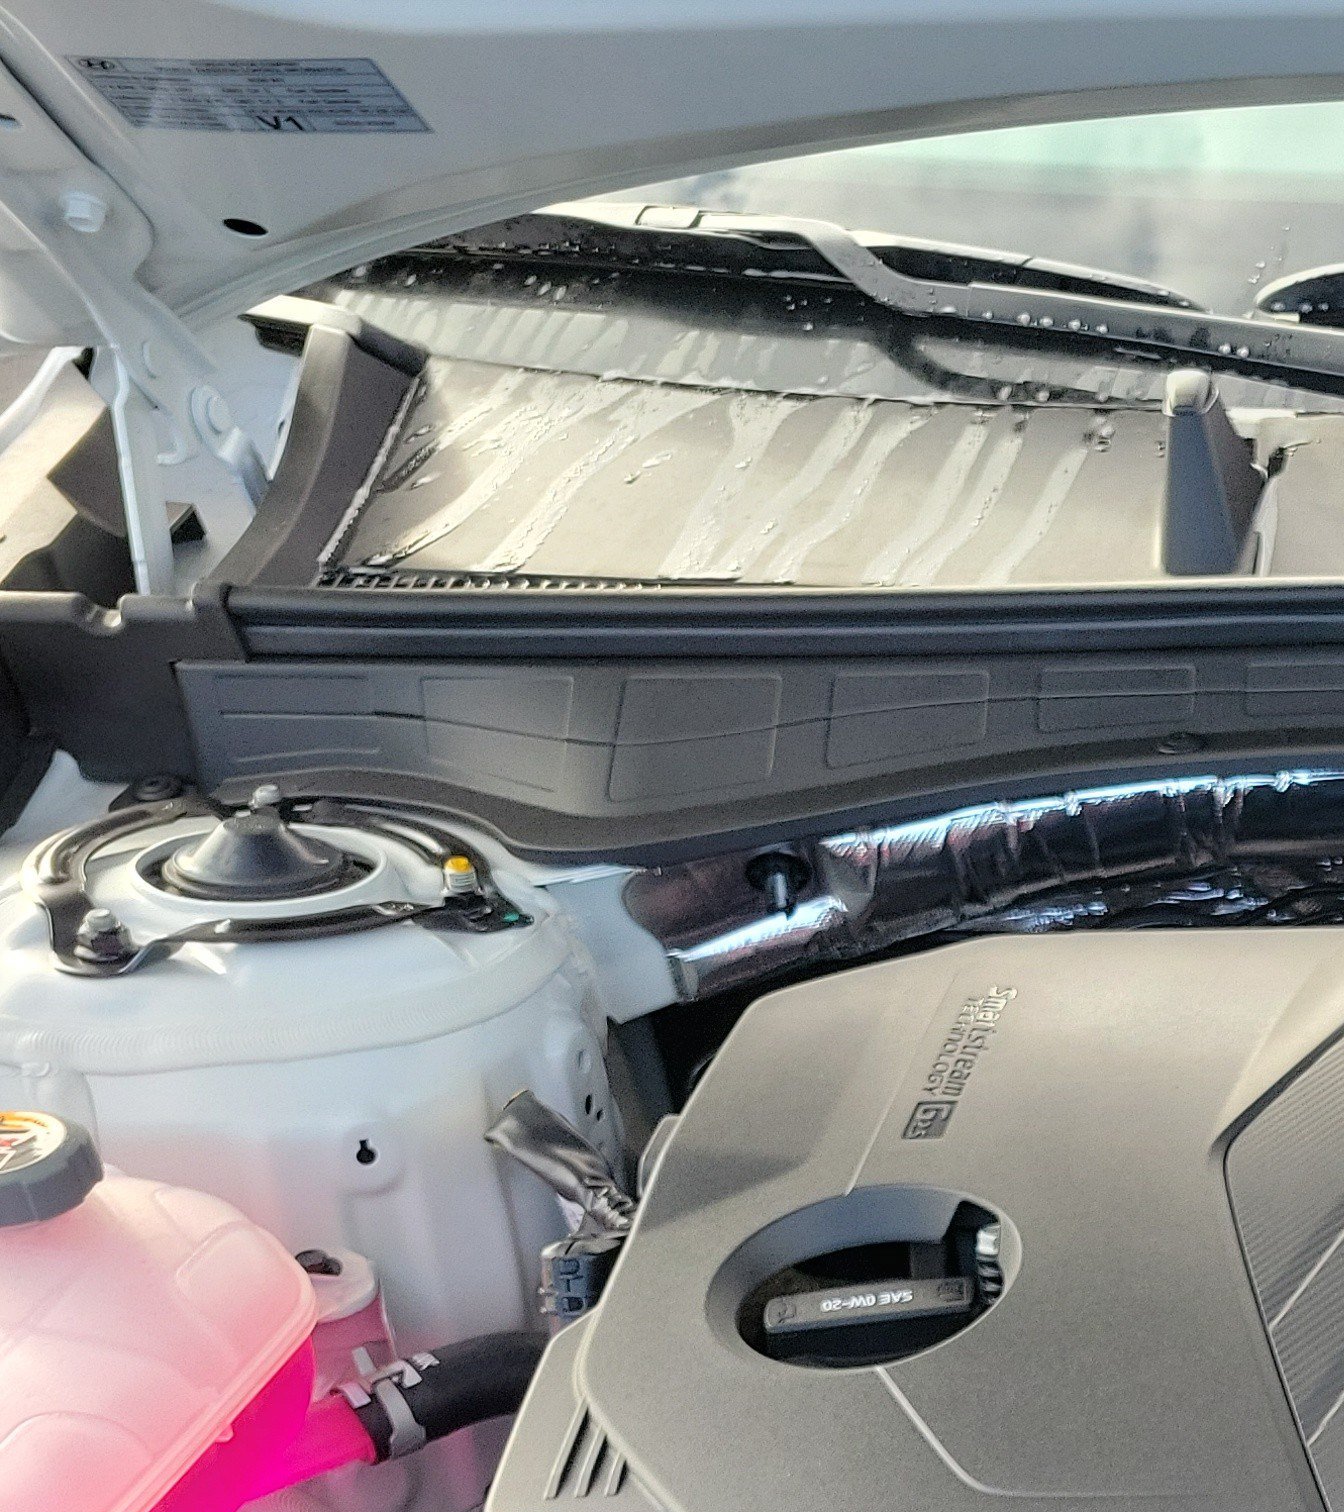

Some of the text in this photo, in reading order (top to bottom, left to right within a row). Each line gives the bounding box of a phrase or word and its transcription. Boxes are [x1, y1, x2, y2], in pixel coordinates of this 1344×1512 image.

[922, 997, 984, 1096] TECHNOLOGY
[941, 985, 1018, 1097] Smartstream
[820, 1289, 914, 1313] SAE 0W-20
